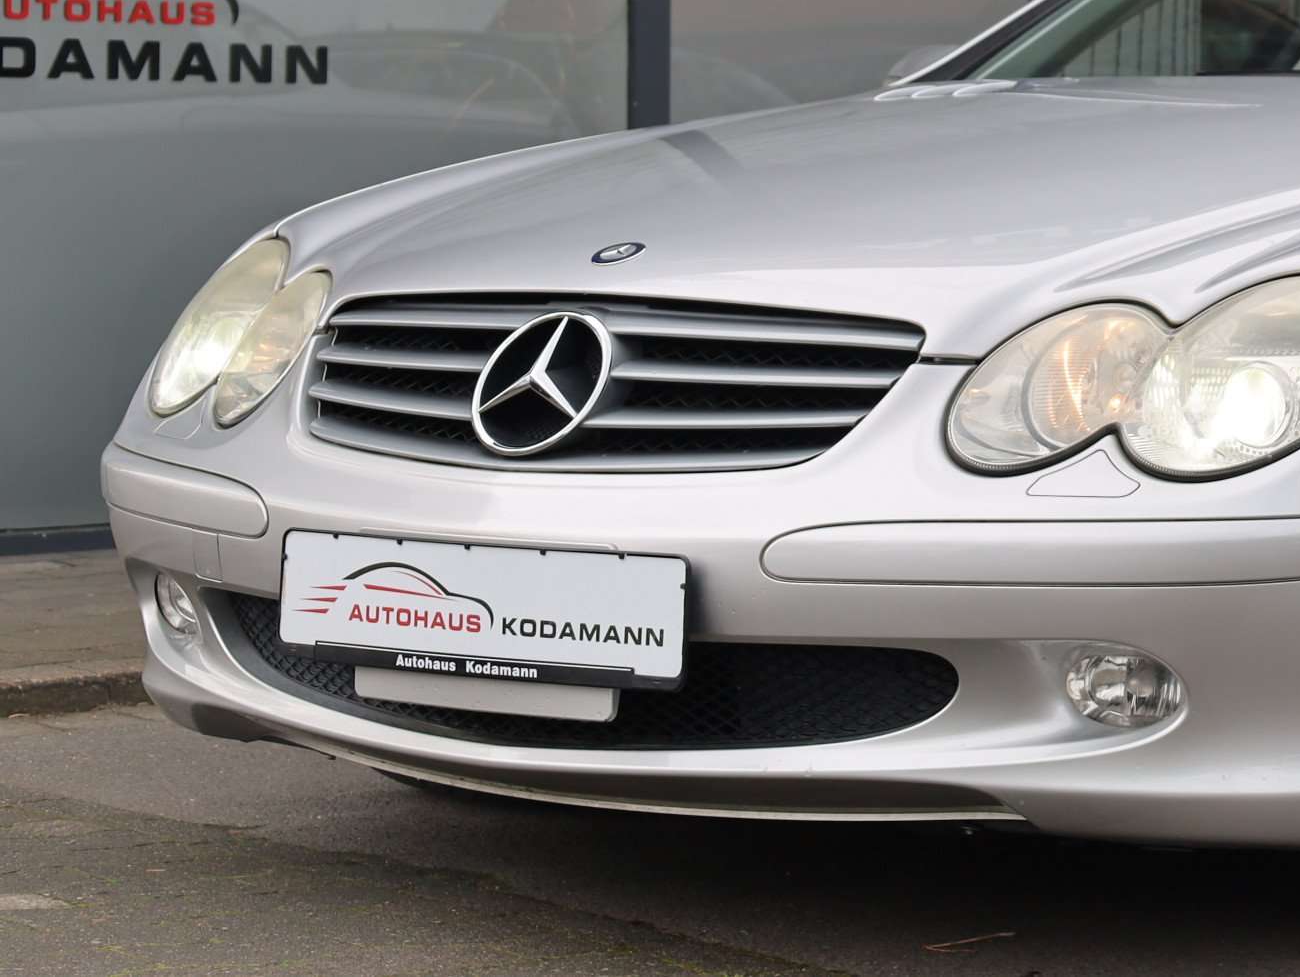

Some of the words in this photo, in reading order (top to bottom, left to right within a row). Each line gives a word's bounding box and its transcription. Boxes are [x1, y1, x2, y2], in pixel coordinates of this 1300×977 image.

[348, 603, 482, 634] AUTOHAUS
[501, 616, 665, 648] KODAMANN
[395, 653, 456, 672] Autohaus
[465, 660, 539, 679] Kodamann
